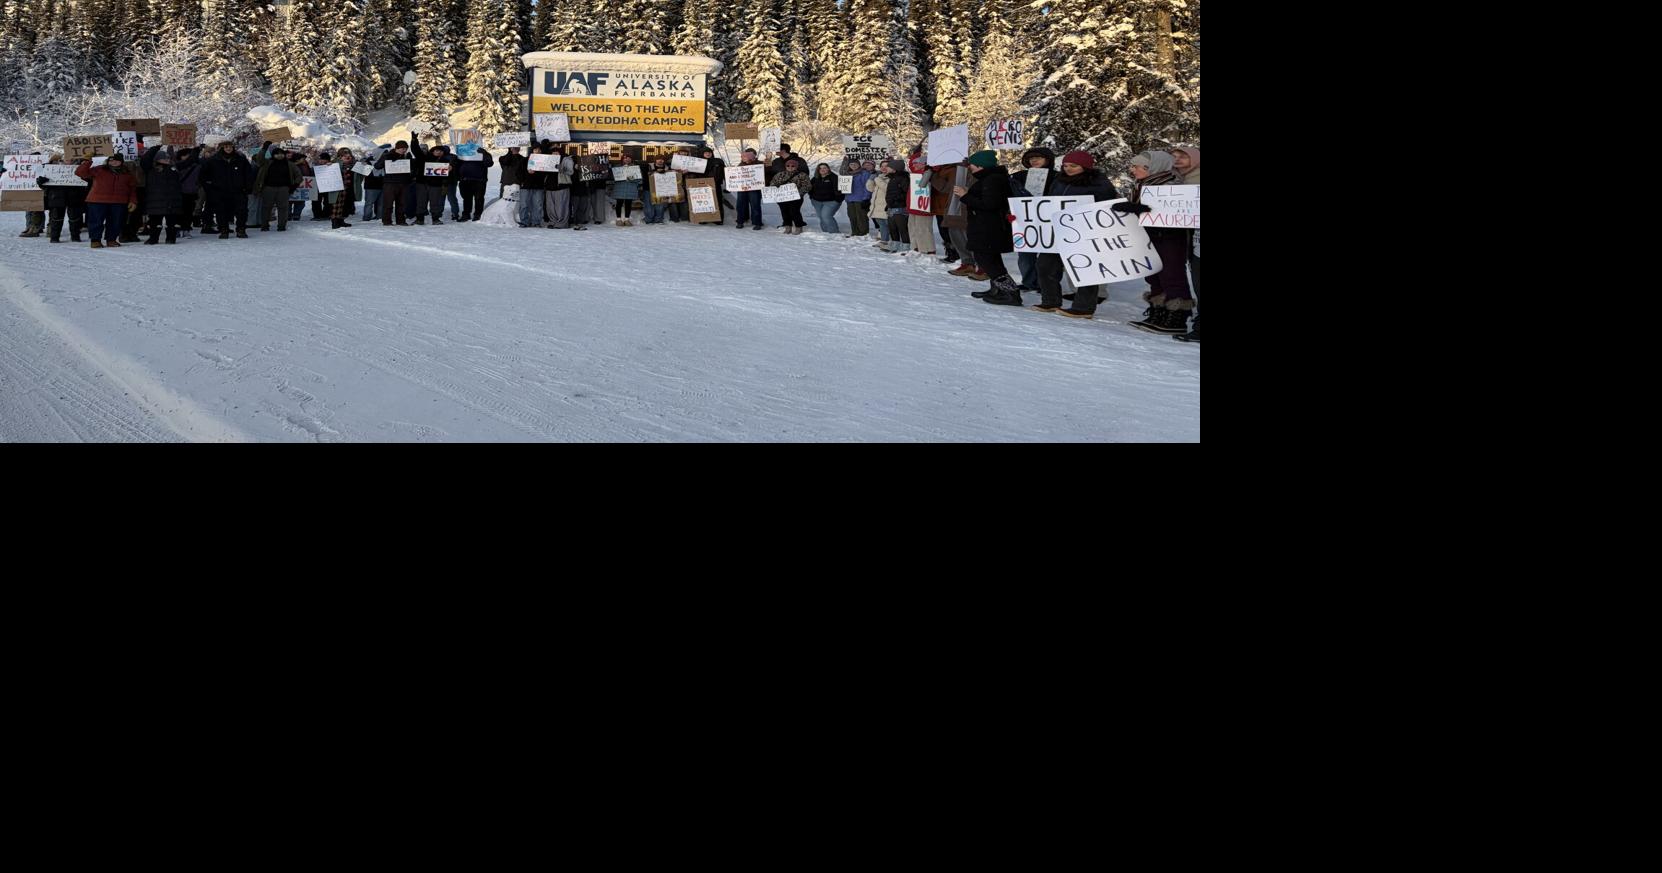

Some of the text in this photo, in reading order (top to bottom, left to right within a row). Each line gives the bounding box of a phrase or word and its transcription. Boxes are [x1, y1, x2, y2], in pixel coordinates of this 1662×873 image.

[544, 71, 609, 96] UAF
[615, 80, 695, 91] ALASKA
[550, 103, 688, 114] WELCOME TO THE UAF
[643, 117, 695, 126] CAMPUS
[66, 137, 110, 146] ABOLISH
[989, 130, 1022, 146] PENIS
[71, 146, 104, 157] ICE
[425, 167, 449, 176] ICE
[1141, 186, 1184, 197] ALL
[1059, 208, 1131, 244] STOP
[1086, 233, 1132, 253] THE
[1066, 253, 1153, 282] PAIN
